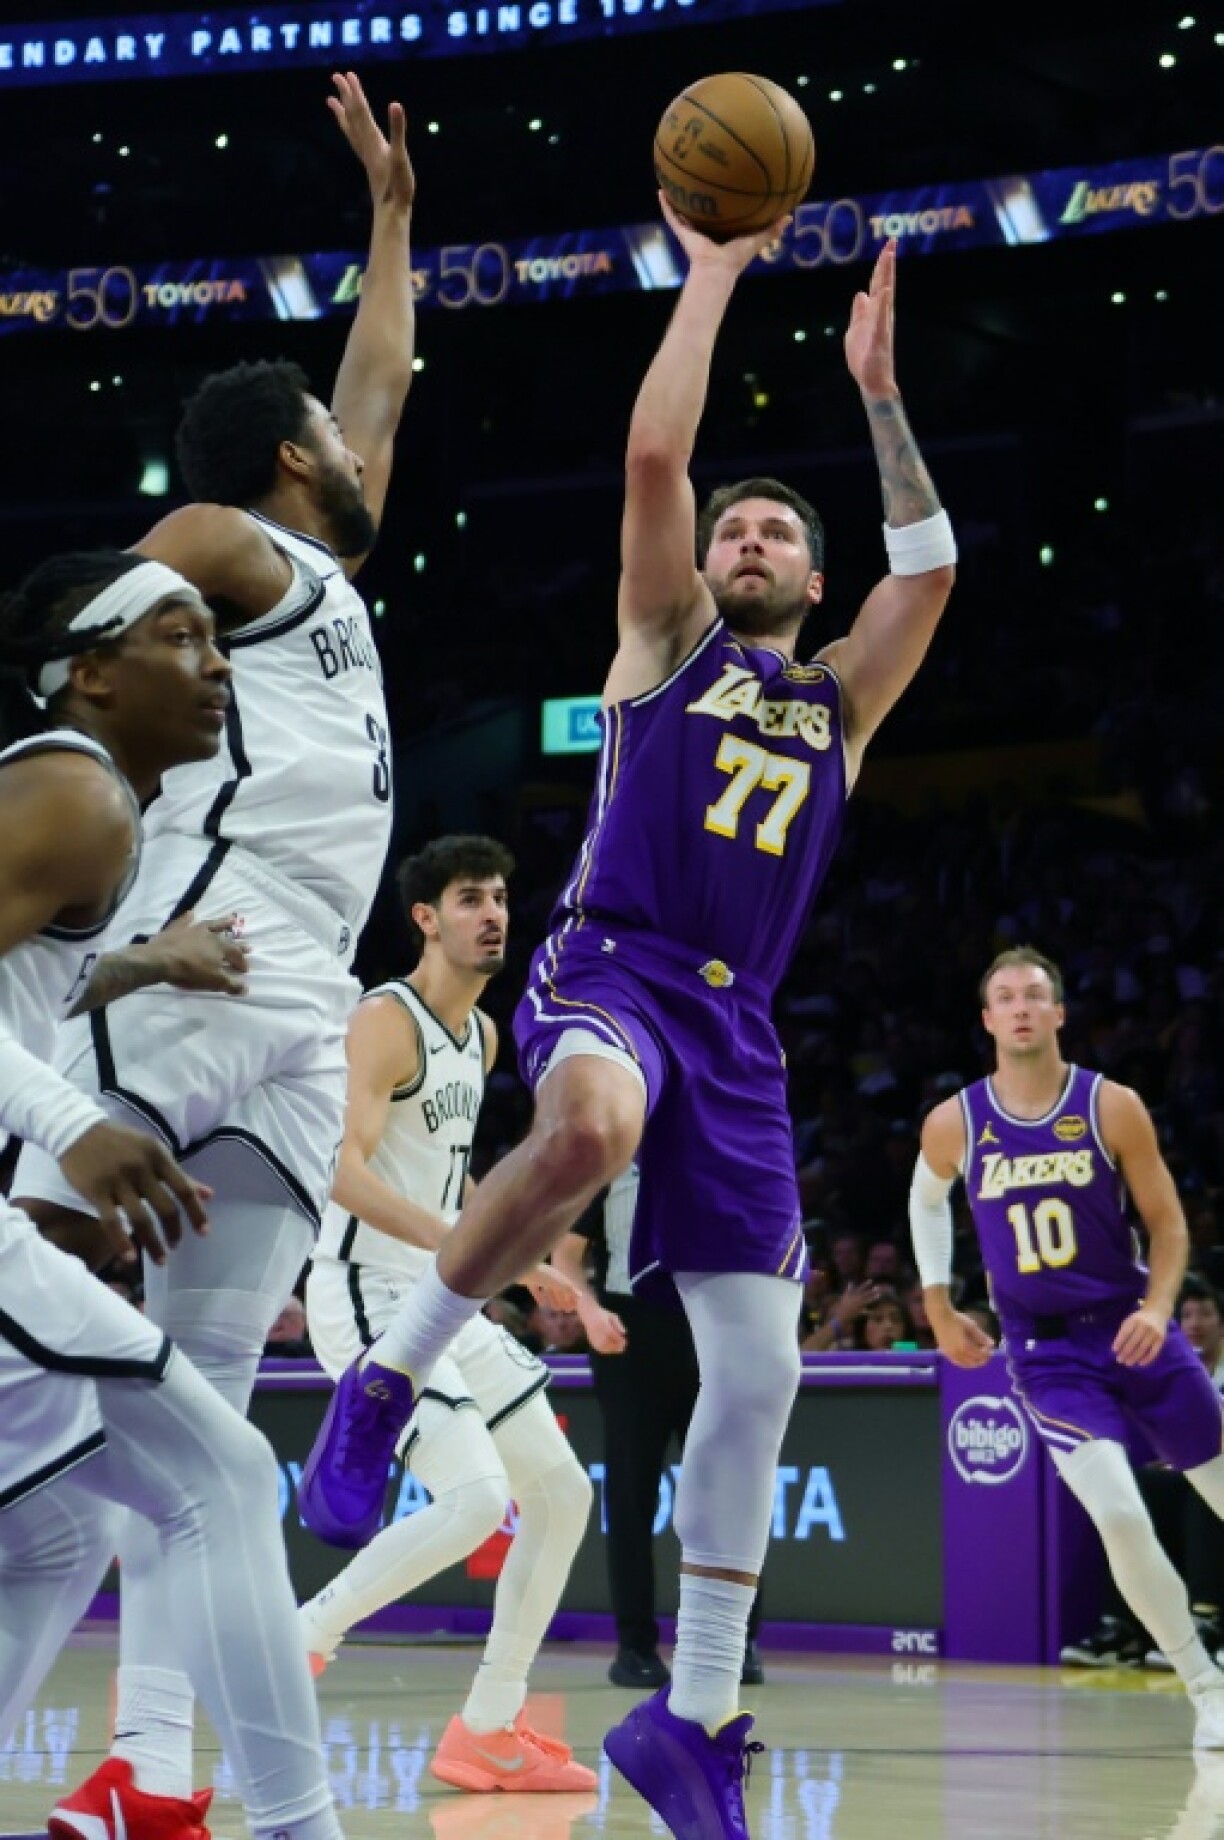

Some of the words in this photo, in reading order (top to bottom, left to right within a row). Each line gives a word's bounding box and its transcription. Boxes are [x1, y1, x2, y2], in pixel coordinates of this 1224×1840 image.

[190, 13, 423, 56] PARTNERS
[447, 0, 578, 37] SINCE
[792, 198, 863, 269] 50
[869, 205, 976, 241] TOYOTA
[65, 265, 138, 330] 50
[142, 278, 247, 309] TOYOTA
[437, 242, 509, 309] 50
[514, 251, 613, 285] TOYOTA
[685, 662, 833, 752] LAERS
[703, 732, 812, 857] 77
[977, 1149, 1095, 1200] LAKERS
[1007, 1198, 1079, 1273] 10
[957, 1417, 1020, 1459] bibigo
